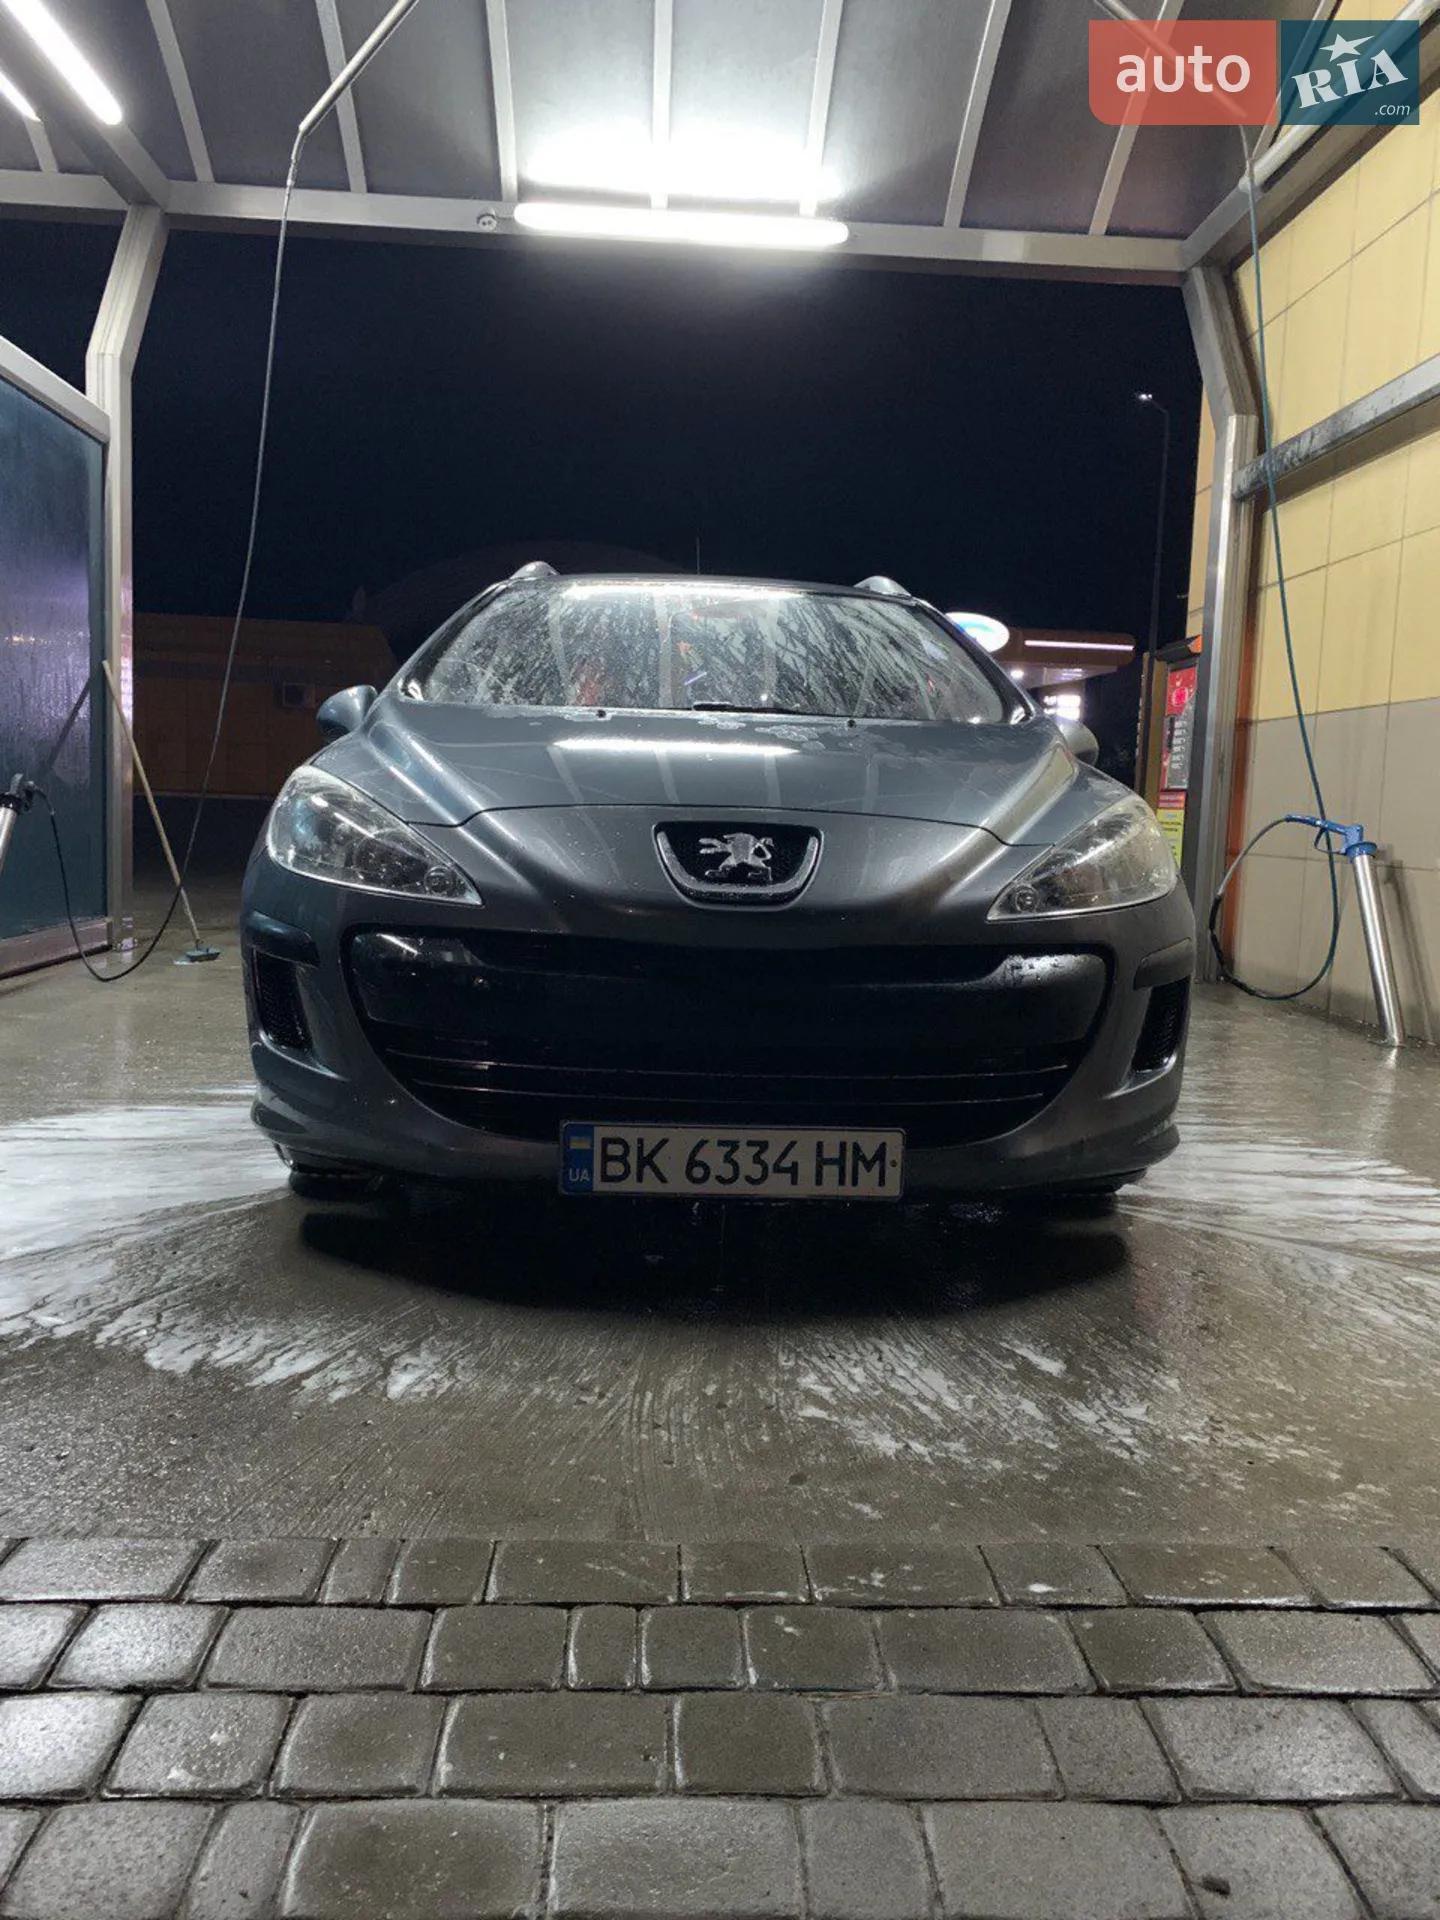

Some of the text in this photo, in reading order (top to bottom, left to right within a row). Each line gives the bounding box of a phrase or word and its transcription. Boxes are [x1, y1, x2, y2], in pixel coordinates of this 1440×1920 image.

[568, 1167, 590, 1183] UA
[600, 1137, 888, 1188] BK 6334 HM
